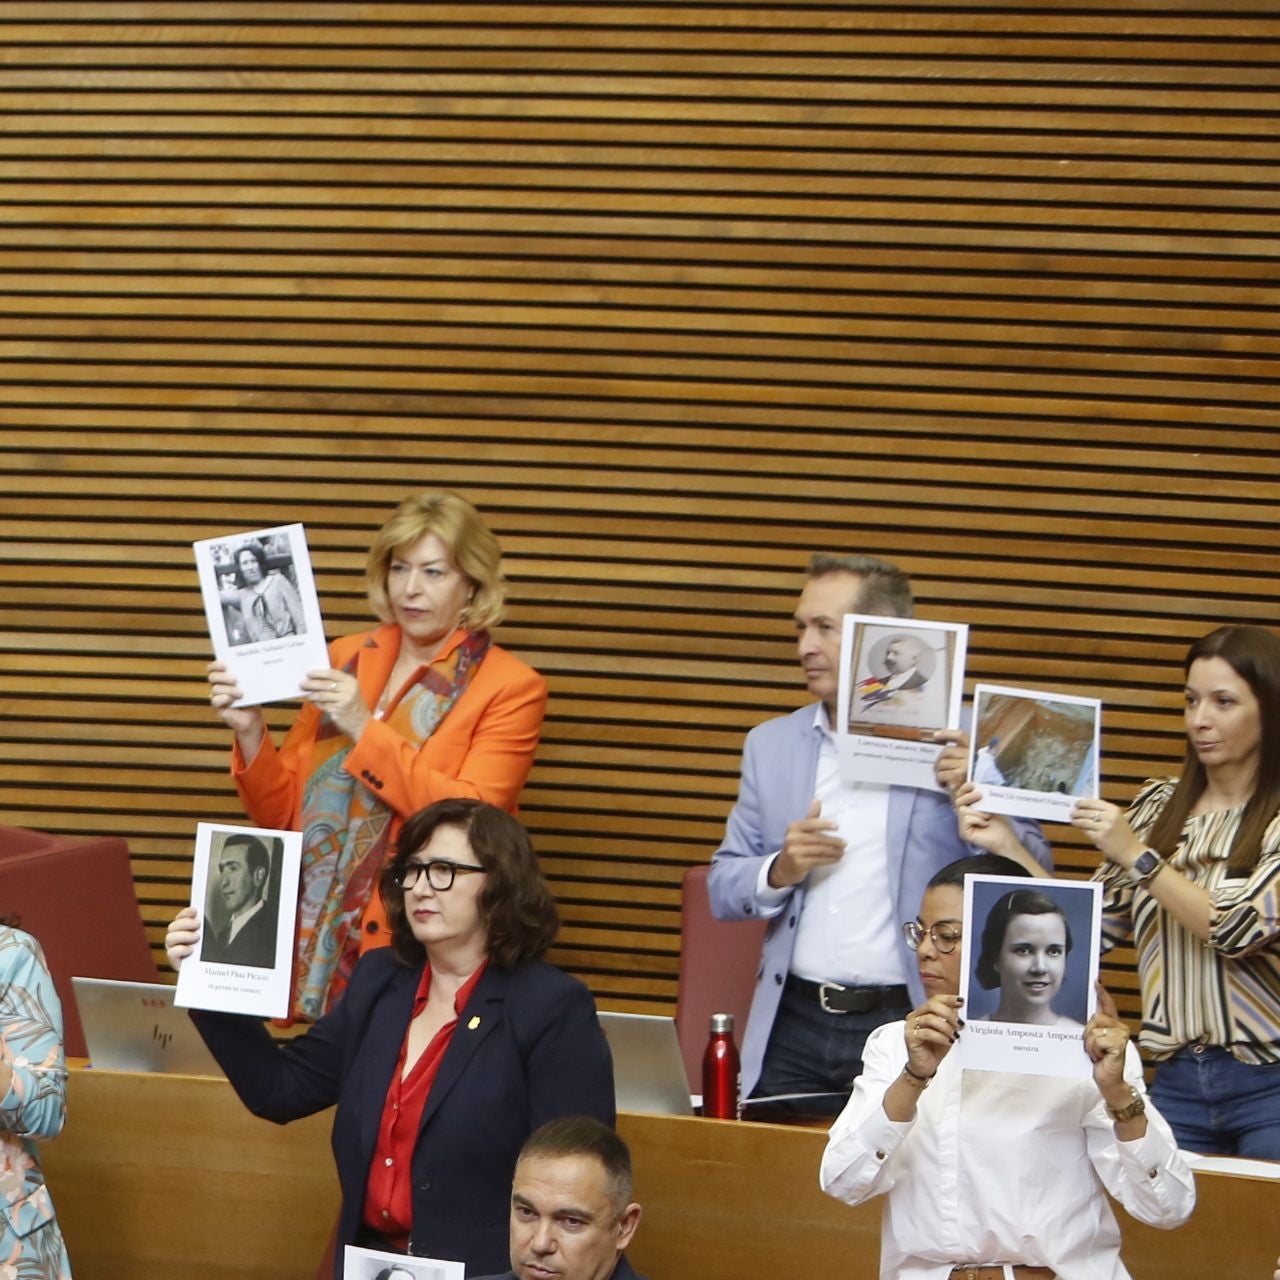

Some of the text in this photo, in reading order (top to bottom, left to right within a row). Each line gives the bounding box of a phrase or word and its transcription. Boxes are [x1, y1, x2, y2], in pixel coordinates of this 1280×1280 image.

[969, 1025, 1084, 1042] Virginia Amposta Amposta
